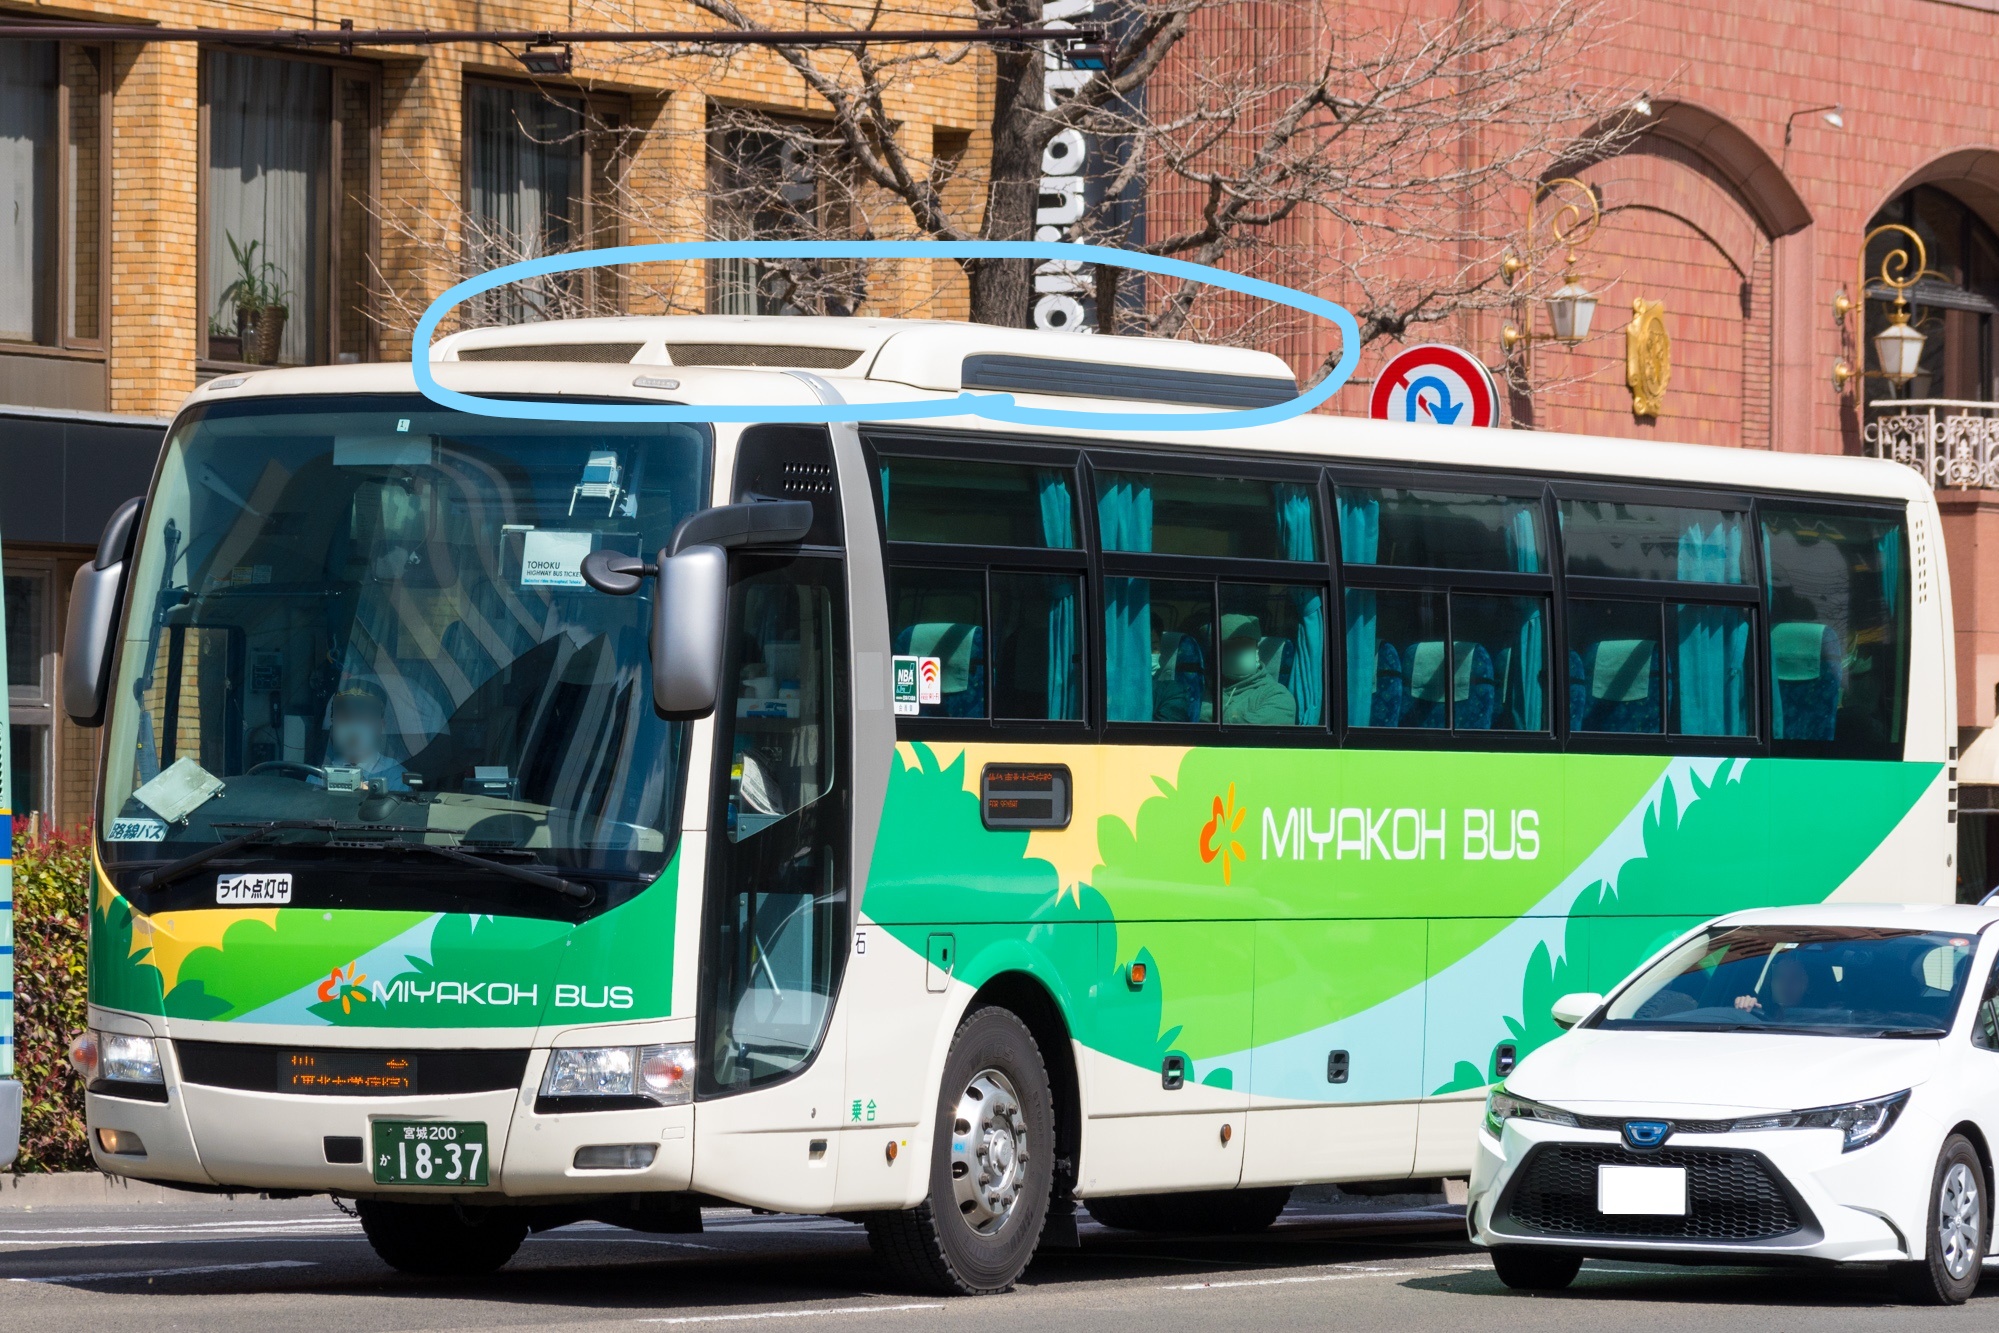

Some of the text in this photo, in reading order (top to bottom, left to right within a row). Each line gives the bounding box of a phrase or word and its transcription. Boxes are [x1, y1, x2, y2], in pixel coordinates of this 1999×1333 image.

[1034, 0, 1094, 333] cDonald
[527, 561, 560, 569] TOHOKU
[898, 669, 913, 682] NBA
[109, 823, 163, 840] 路線バス
[1262, 807, 1540, 860] MIYAKOH BUS
[220, 878, 289, 899] ライト点灯中
[856, 932, 866, 954] 石
[372, 980, 634, 1009] MIYAKOH BUS
[852, 1099, 877, 1122] 乗合
[380, 1142, 482, 1180] か 18-37
